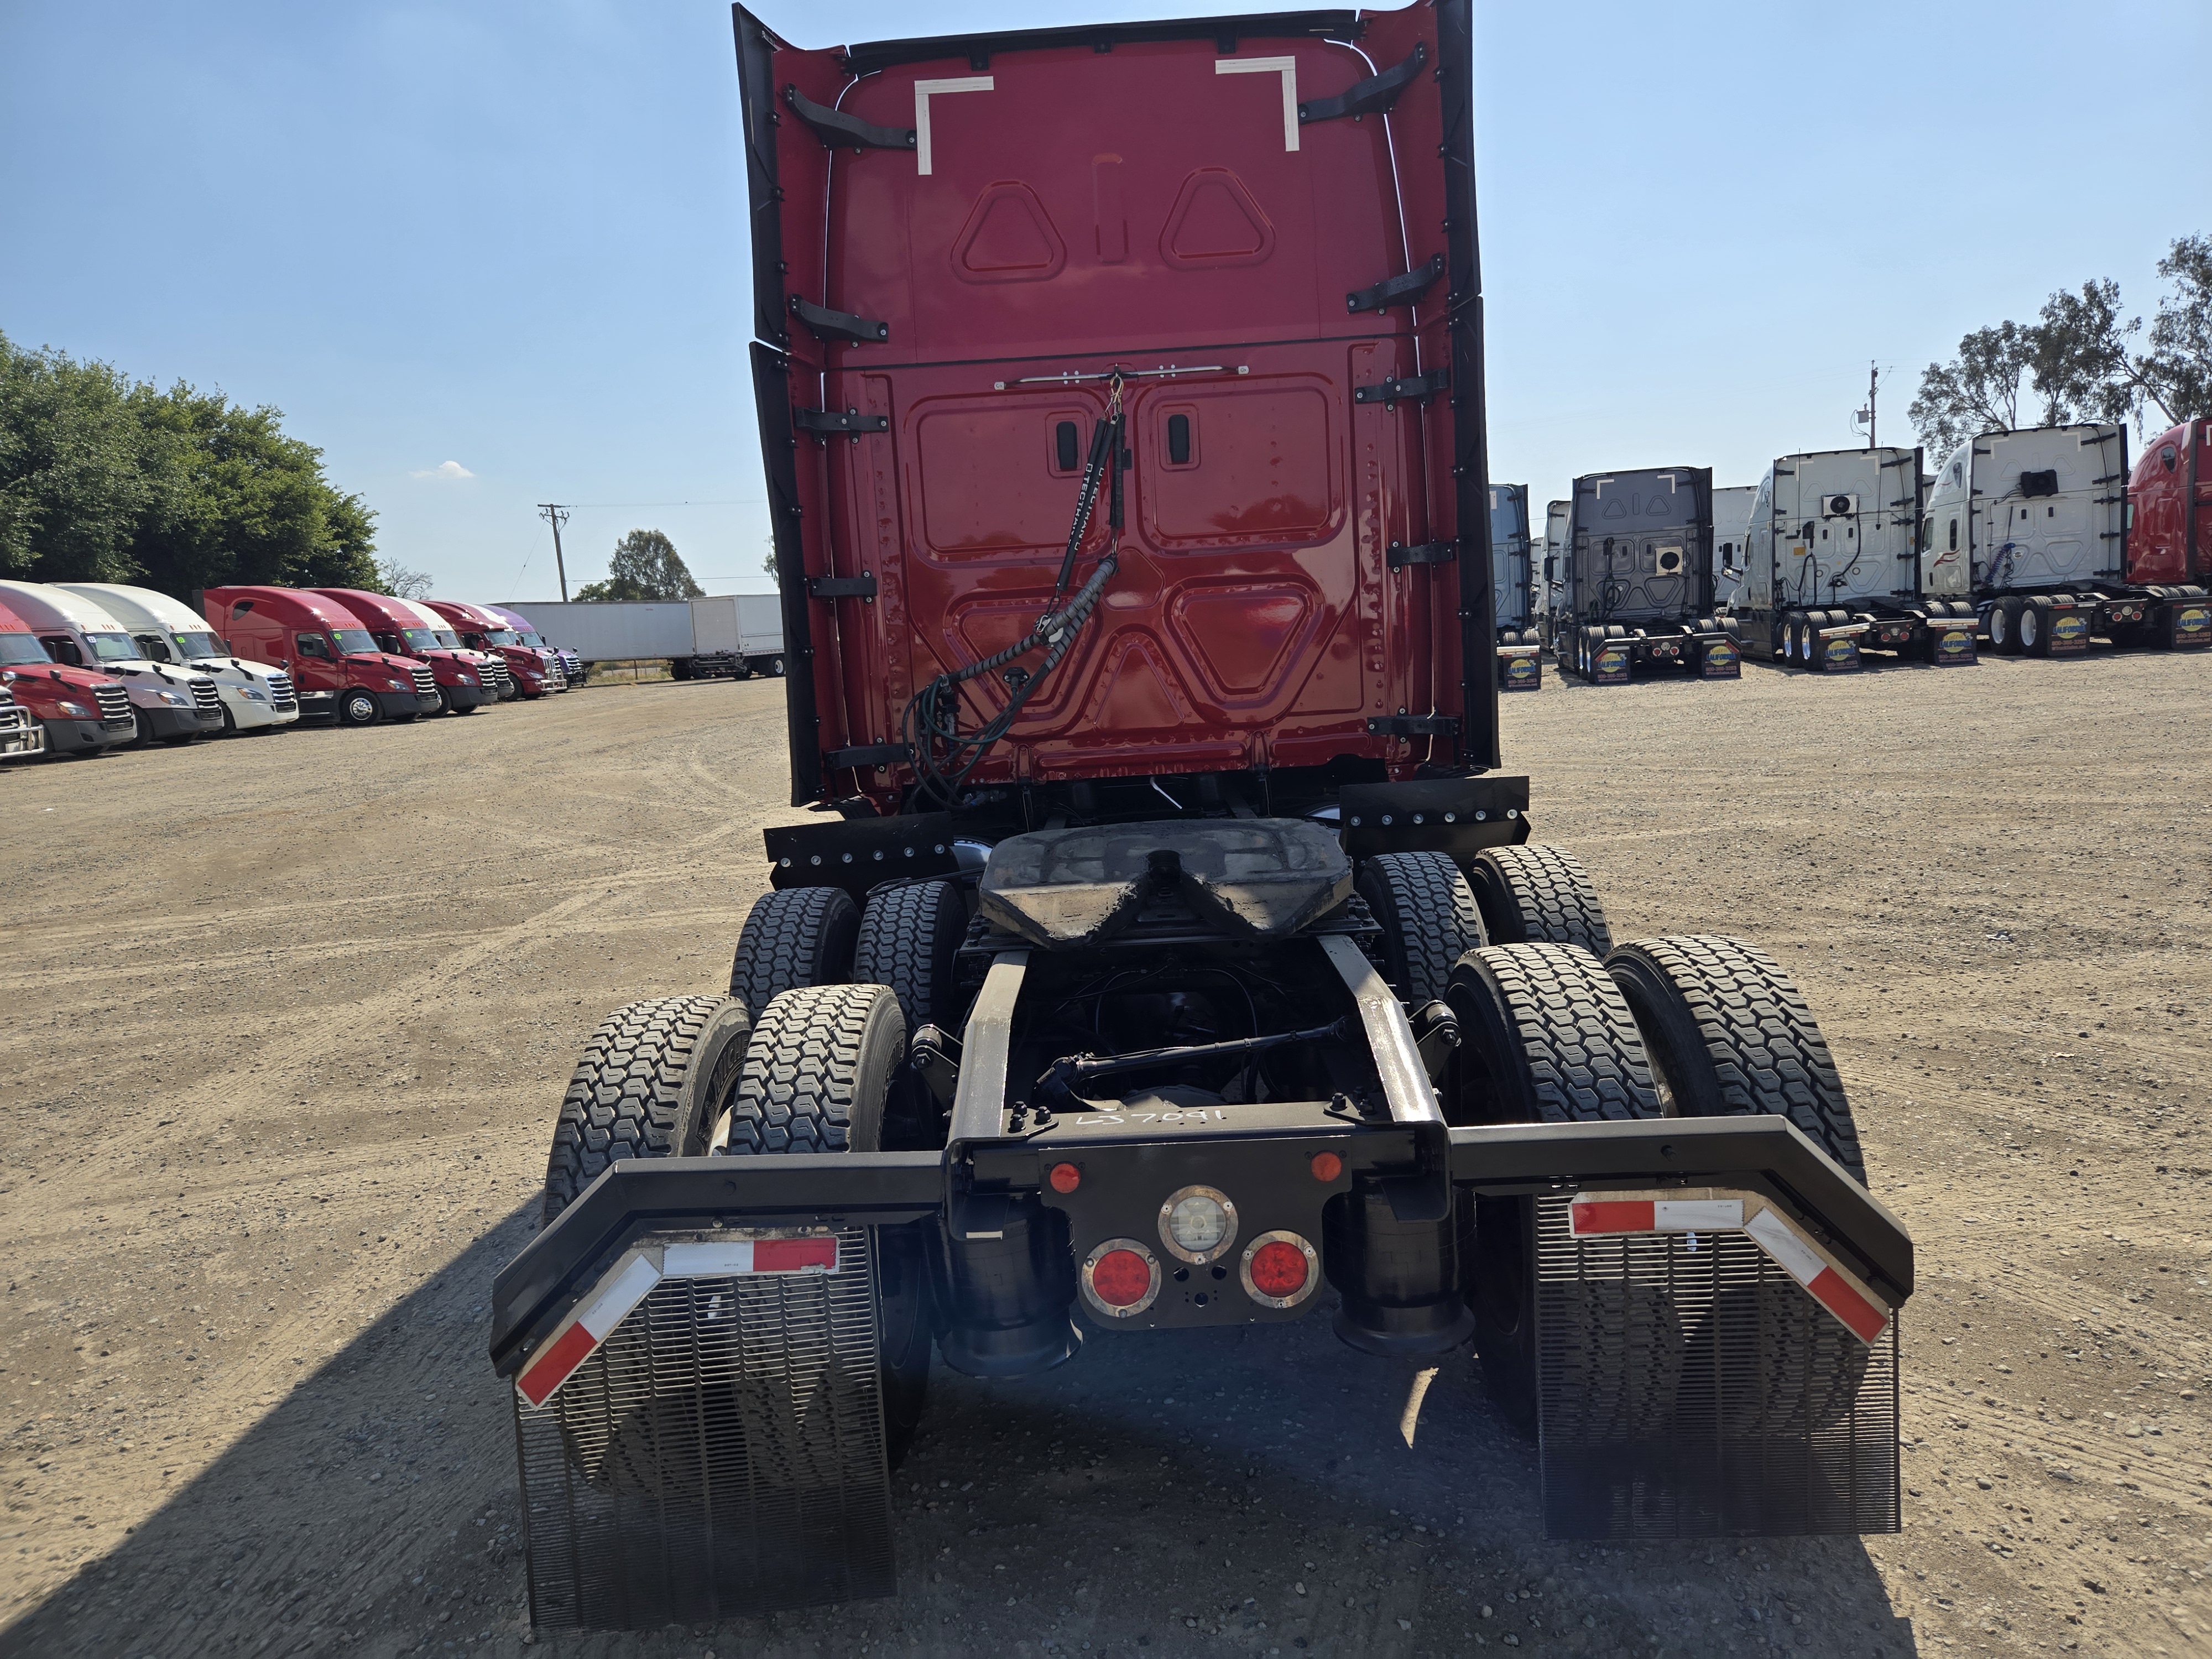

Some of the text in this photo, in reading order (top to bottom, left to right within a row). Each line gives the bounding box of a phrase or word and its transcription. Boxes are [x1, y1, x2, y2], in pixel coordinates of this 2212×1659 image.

[2177, 617, 2210, 627] CALIFORNIA
[2053, 625, 2085, 634] CALIFORNIA
[1940, 639, 1971, 648] CALIFORNIA
[1825, 647, 1855, 656] CALIFORNIA
[1598, 660, 1626, 668] CALIFORNIA
